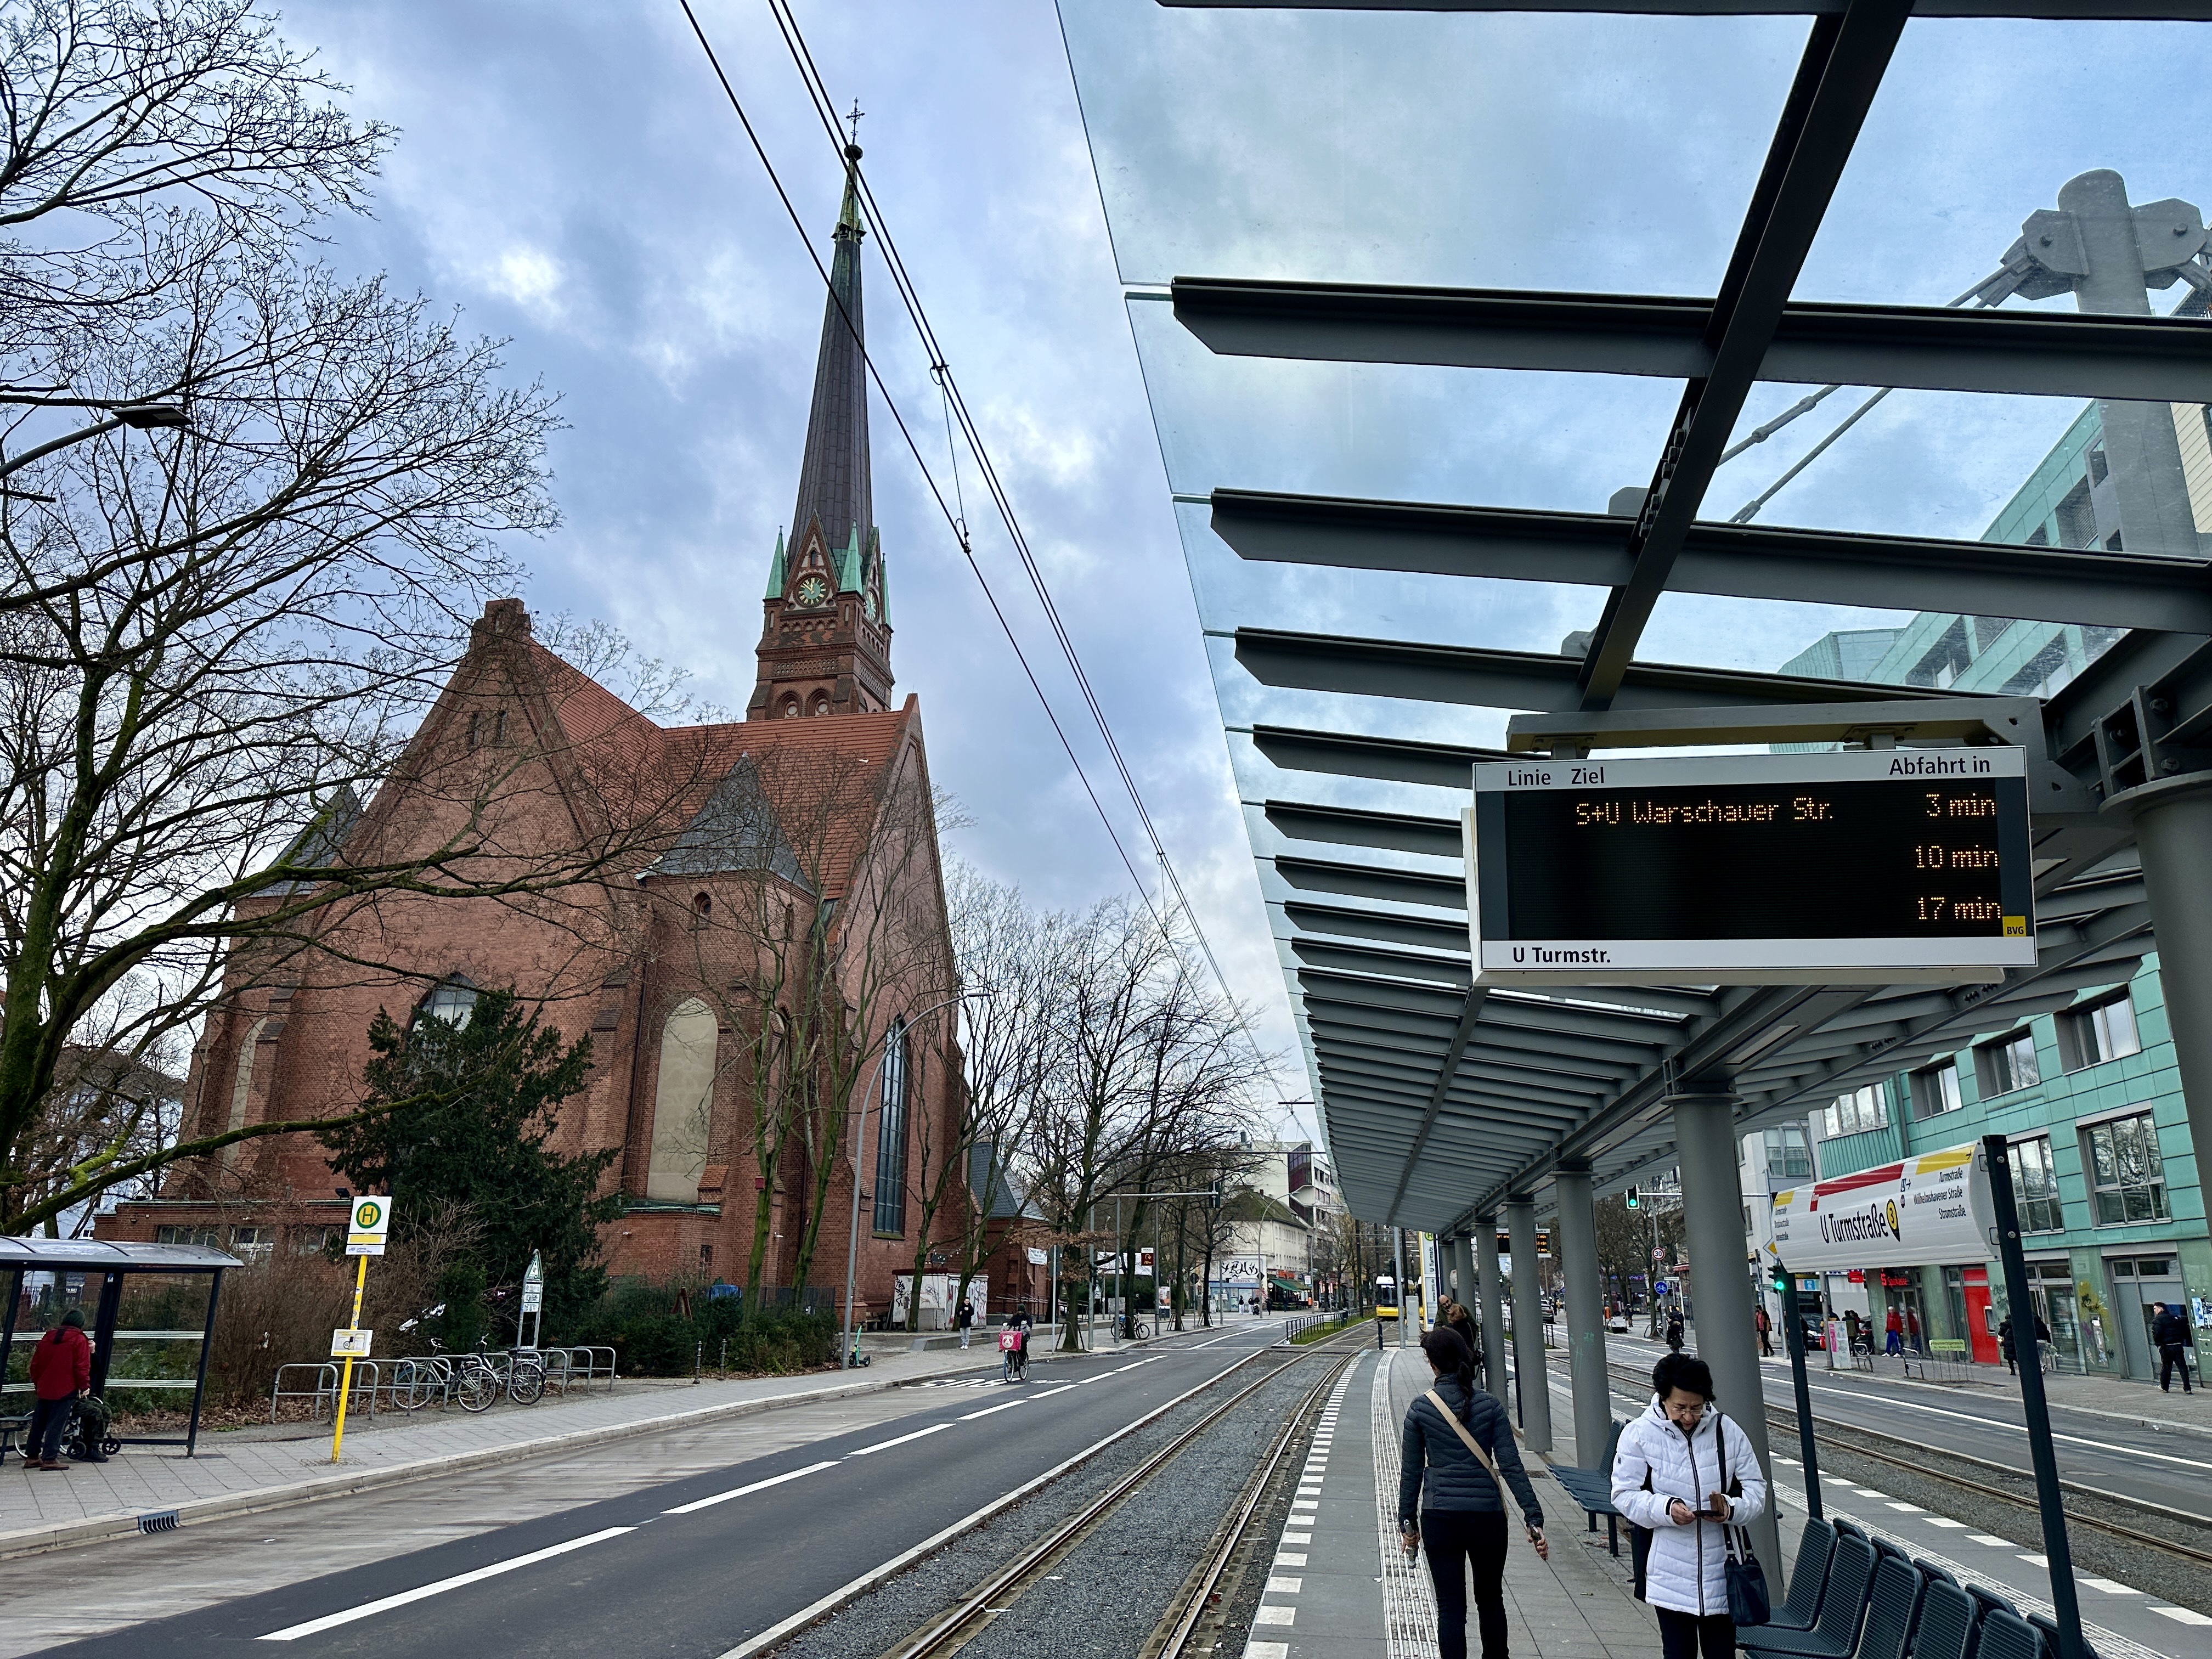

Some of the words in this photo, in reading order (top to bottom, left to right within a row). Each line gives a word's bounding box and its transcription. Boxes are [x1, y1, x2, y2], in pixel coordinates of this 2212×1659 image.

[1889, 756, 1966, 775] Abfahrt
[1973, 755, 1991, 774] in
[1508, 769, 1551, 786] Linie
[1571, 766, 1604, 785] Ziel
[1576, 802, 1619, 825] S+U
[1633, 799, 1779, 823] Warschauer
[1792, 797, 1833, 820] Str.
[1926, 793, 1940, 817] 3
[1949, 792, 1996, 817] min
[1915, 845, 1943, 868] 10
[1951, 844, 1999, 868] min
[1917, 896, 1945, 920] 17
[1954, 895, 2001, 919] min
[2006, 926, 2024, 935] BVG
[1513, 947, 1525, 963] U
[1532, 947, 1611, 963] Turmstr.
[1939, 1167, 1963, 1183] Turmstraße
[1913, 1190, 1948, 1205] Wilhelmshavener
[1948, 1185, 1963, 1200] Straße
[362, 1207, 374, 1223] H
[1889, 1207, 1895, 1224] 3
[1938, 1204, 1967, 1220] Stromstraße
[1820, 1214, 1830, 1244] U
[1828, 1203, 1889, 1243] Turmstraße
